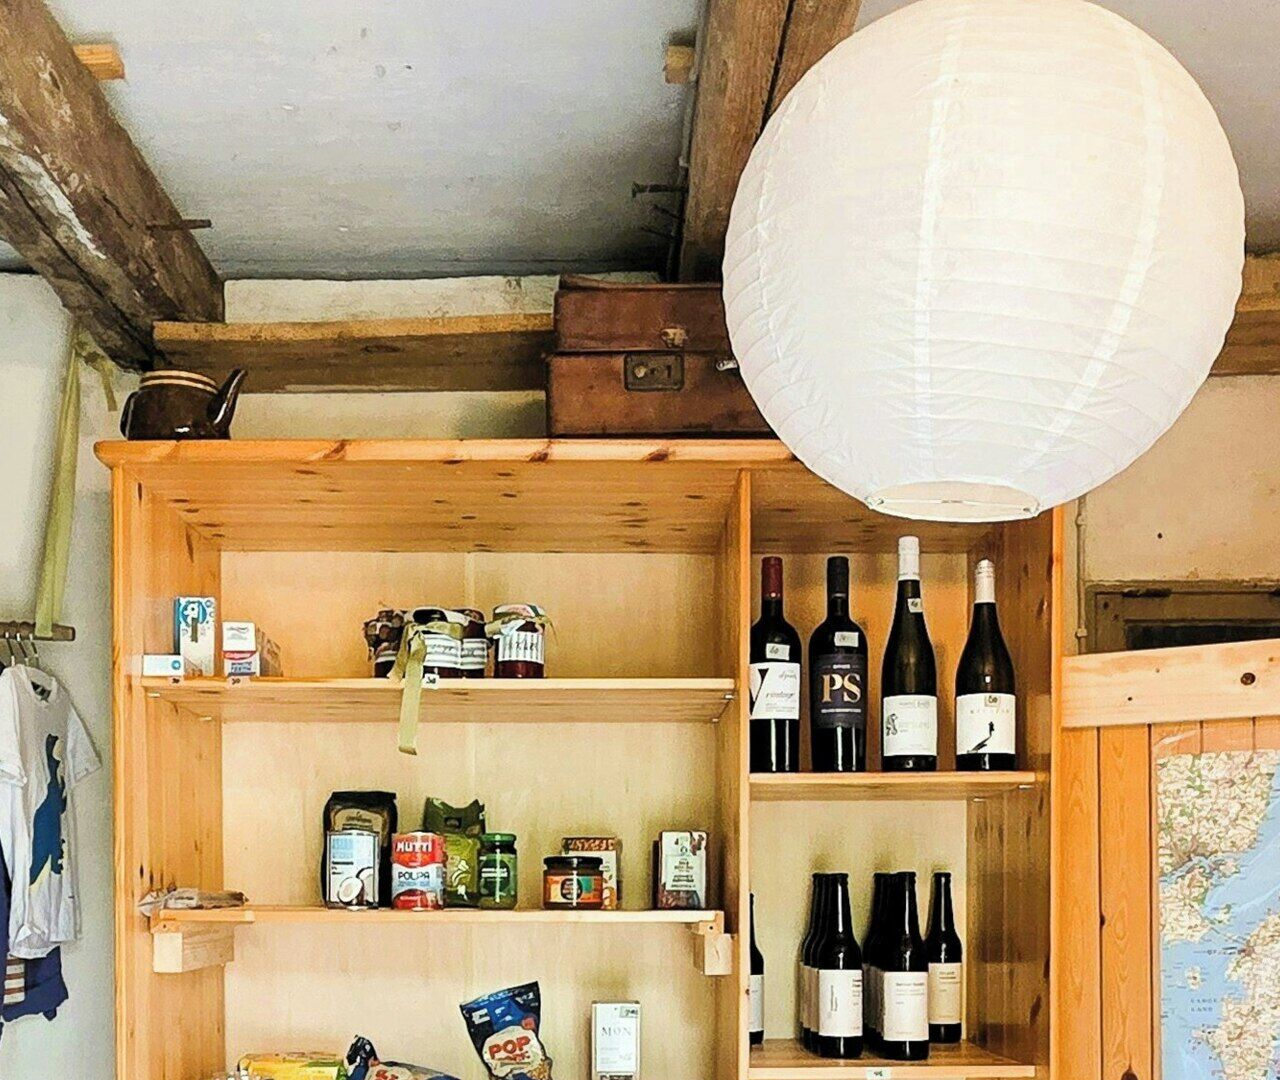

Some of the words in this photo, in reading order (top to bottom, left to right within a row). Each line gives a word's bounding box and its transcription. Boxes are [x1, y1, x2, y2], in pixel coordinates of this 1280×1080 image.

[822, 673, 861, 703] PS
[395, 840, 433, 853] MUTTI
[397, 871, 430, 881] POLPA
[488, 1035, 531, 1061] POP
